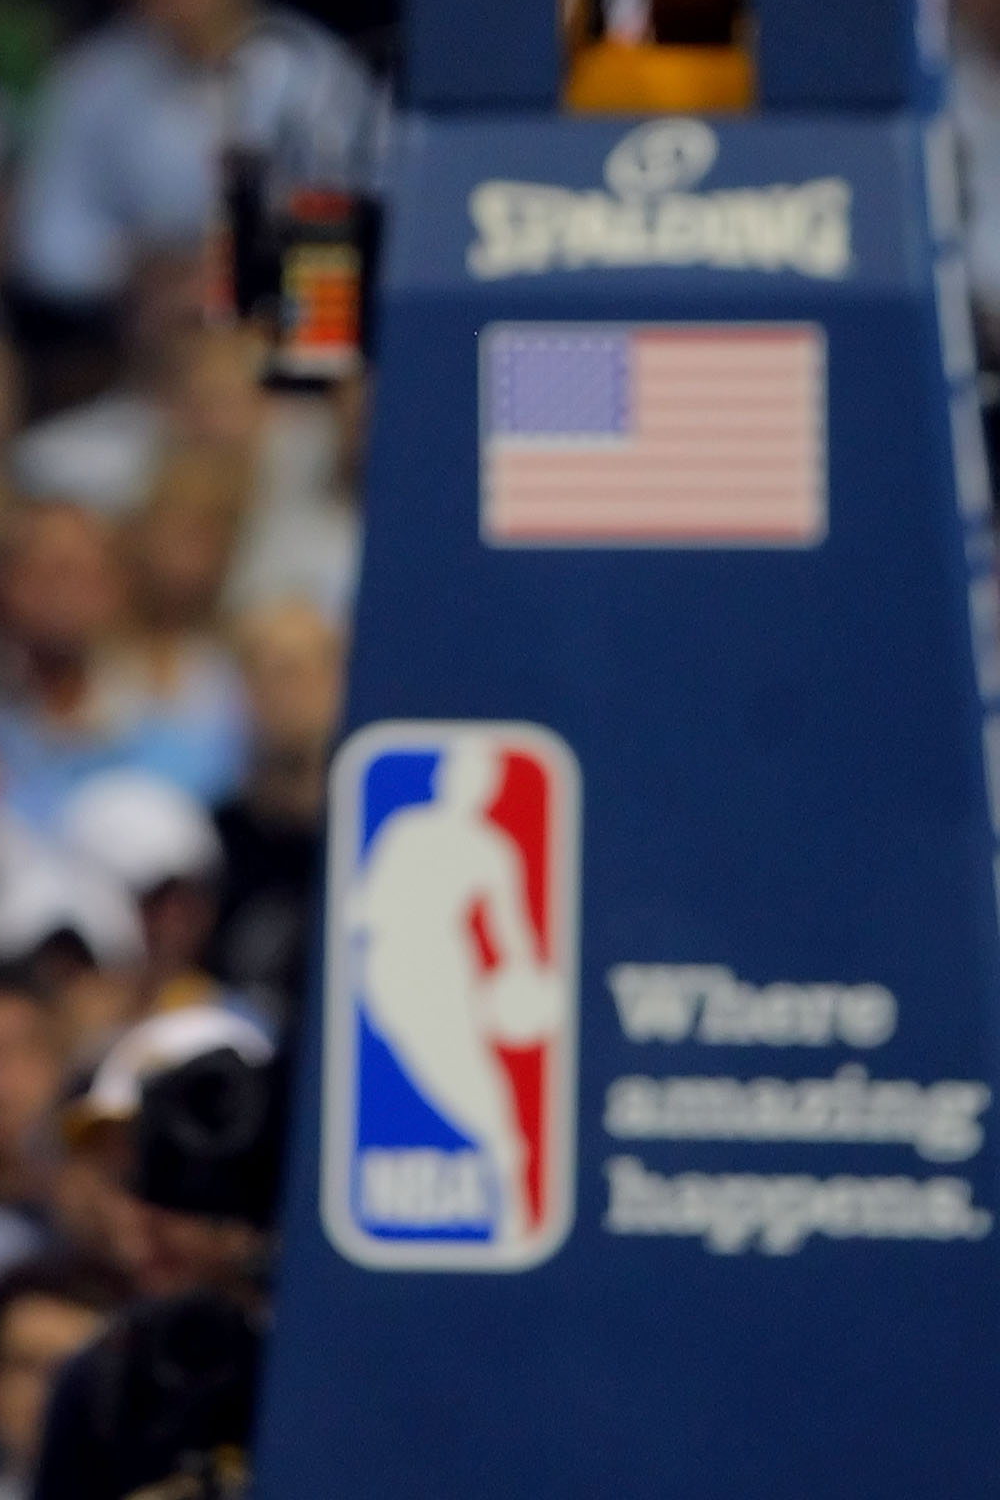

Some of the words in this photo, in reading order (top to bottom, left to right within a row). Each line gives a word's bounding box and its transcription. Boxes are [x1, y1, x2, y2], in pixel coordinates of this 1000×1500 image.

[467, 179, 852, 280] SPALDING
[606, 964, 897, 1047] Where
[605, 1064, 990, 1162] amazing
[362, 1151, 487, 1222] NBA
[604, 1156, 992, 1255] happens.
